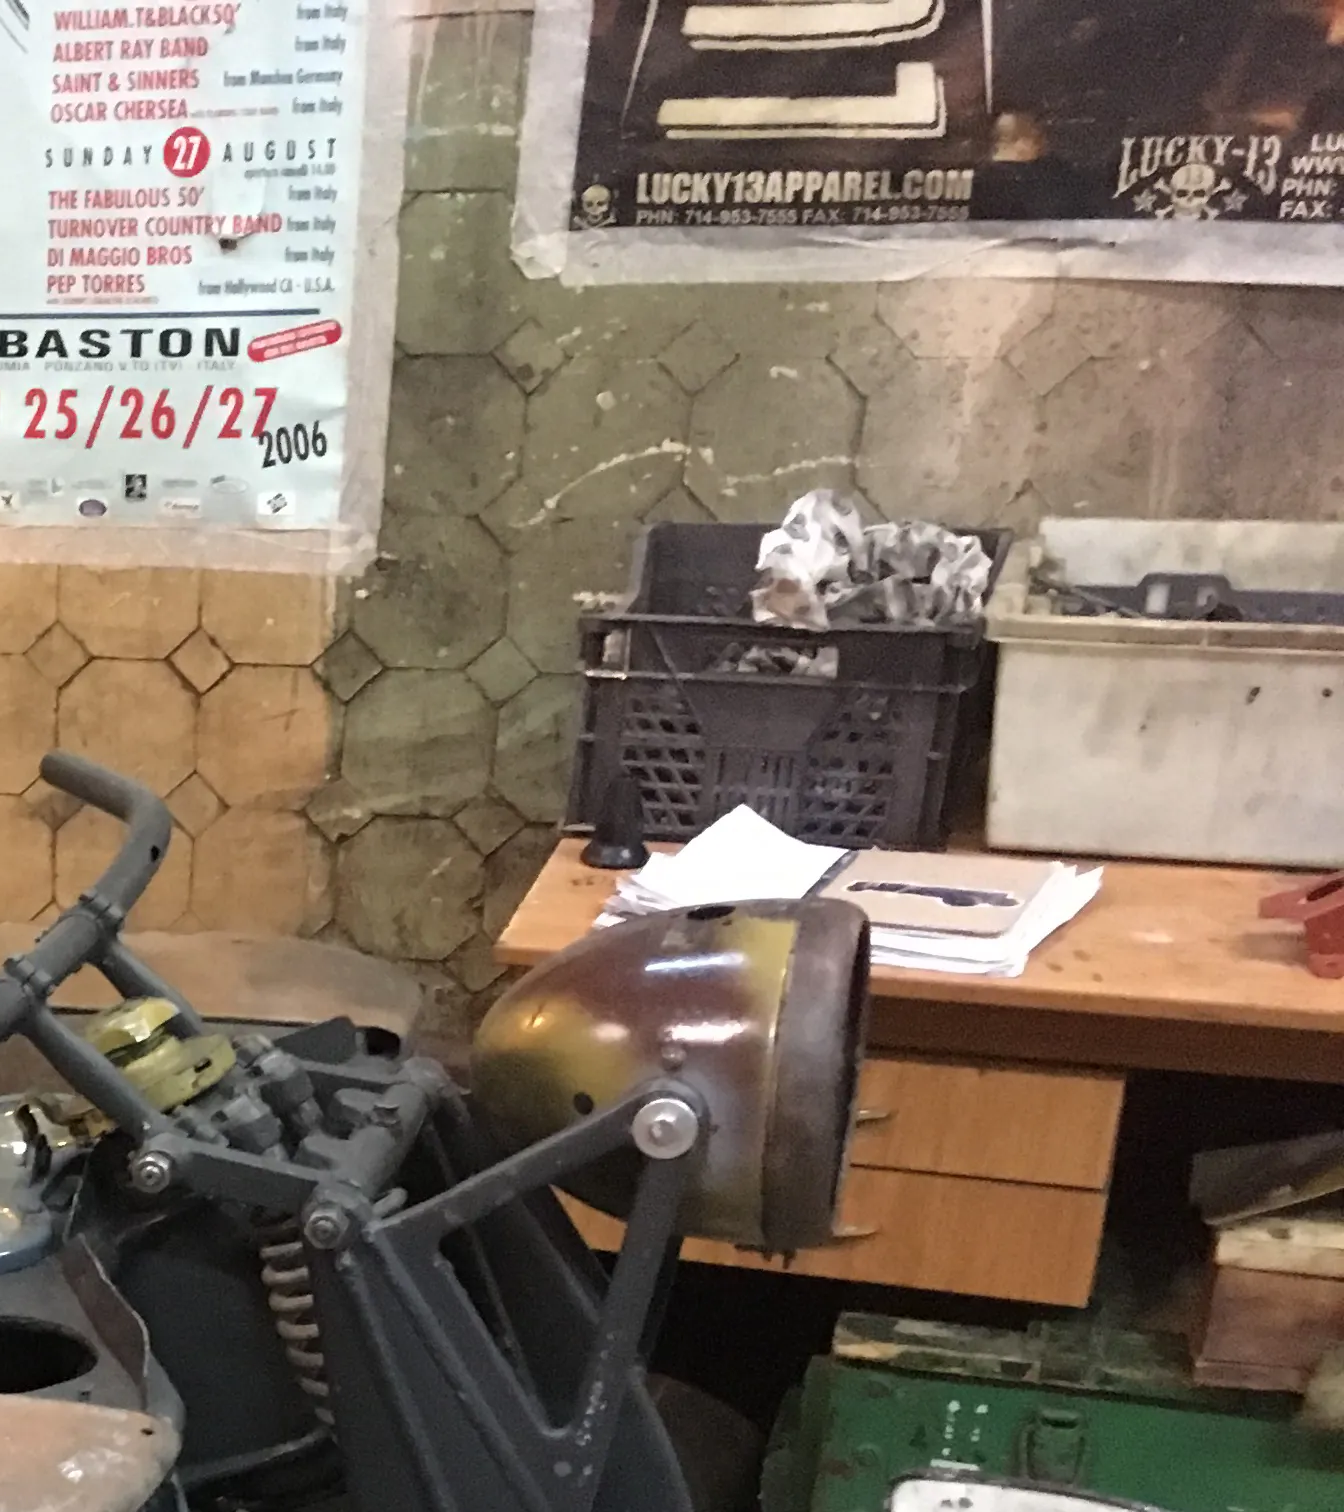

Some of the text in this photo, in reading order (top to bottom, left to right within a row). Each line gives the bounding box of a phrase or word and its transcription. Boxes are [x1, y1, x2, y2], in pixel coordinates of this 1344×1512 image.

[53, 37, 209, 62] ALBERT RAY BAND
[52, 68, 200, 93] SAINT & SINNERS
[50, 102, 107, 123] OSCAR
[114, 99, 188, 121] CHERSEA
[45, 135, 337, 170] SUNDAY 27 AUGUST
[48, 190, 77, 210] THE
[84, 188, 171, 210] FABULOUS
[636, 169, 975, 204] LUCKY13APPAREL.COM
[48, 212, 283, 239] TURNOVER COUNTRY BAND
[47, 245, 193, 267] DI MAGGIO BROS
[47, 274, 146, 294] PEP TORRES
[23, 385, 279, 449] 25/26/27
[258, 420, 329, 469] 2006
